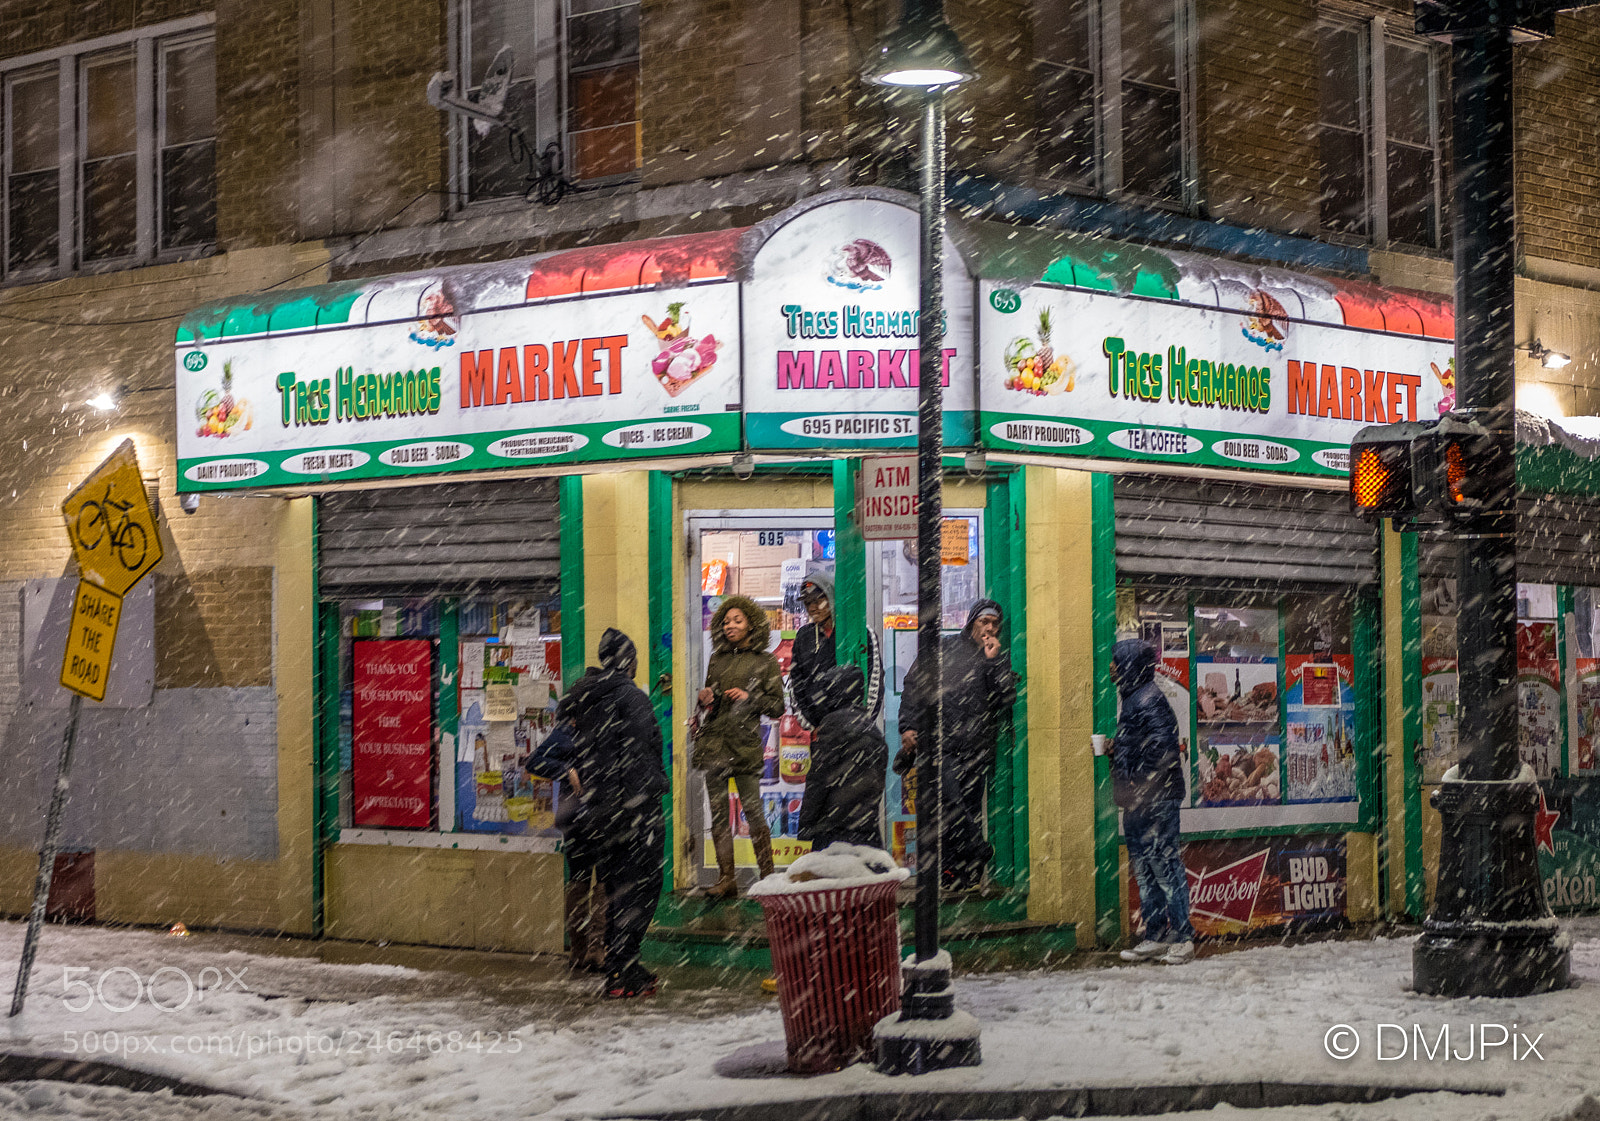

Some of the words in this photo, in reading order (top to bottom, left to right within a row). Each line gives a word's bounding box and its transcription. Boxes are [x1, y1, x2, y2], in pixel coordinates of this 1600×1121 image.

[460, 334, 628, 409] MARKET
[1287, 359, 1422, 424] MARKET
[619, 429, 645, 445] JUICES
[653, 428, 667, 442] ICE
[668, 425, 694, 441] CREAM
[802, 420, 831, 434] 695
[835, 419, 890, 434] PACIFIC
[893, 418, 912, 434] ST.
[1006, 423, 1034, 441] DAIRY
[1036, 425, 1081, 444] PRODUCTS
[500, 437, 537, 448] PRODUCTOS
[538, 434, 575, 445] MEXICANOS
[1128, 430, 1148, 451] TEA
[1150, 431, 1188, 453] COFFEE
[390, 449, 410, 464] COLD
[411, 447, 428, 463] BEER
[435, 445, 460, 461] SODAS
[1223, 441, 1242, 457] COLD
[1243, 443, 1260, 459] BEER
[1265, 445, 1289, 462] SODAS
[197, 463, 218, 481] DAIRY
[219, 462, 258, 479] PRODUCTS
[302, 456, 326, 471] FRESH
[328, 453, 354, 469] MEATS
[875, 466, 910, 488] ATM
[866, 494, 919, 518] INSIDE
[758, 531, 785, 546] 695
[79, 595, 115, 627] SHARE
[81, 626, 104, 654] THE
[70, 654, 101, 685] ROAD
[365, 663, 397, 676] THANK
[397, 662, 418, 675] YOU
[359, 690, 377, 703] FOR
[377, 689, 424, 703] SHOPPING
[378, 716, 402, 729] HERE
[359, 742, 383, 755] YOUR
[383, 743, 426, 756] BUSINESS
[385, 769, 395, 781] IS
[362, 795, 423, 811] APPRECIATED
[1289, 856, 1329, 884] BUD
[1189, 865, 1261, 905] dweiser
[1283, 881, 1338, 912] LIGHT
